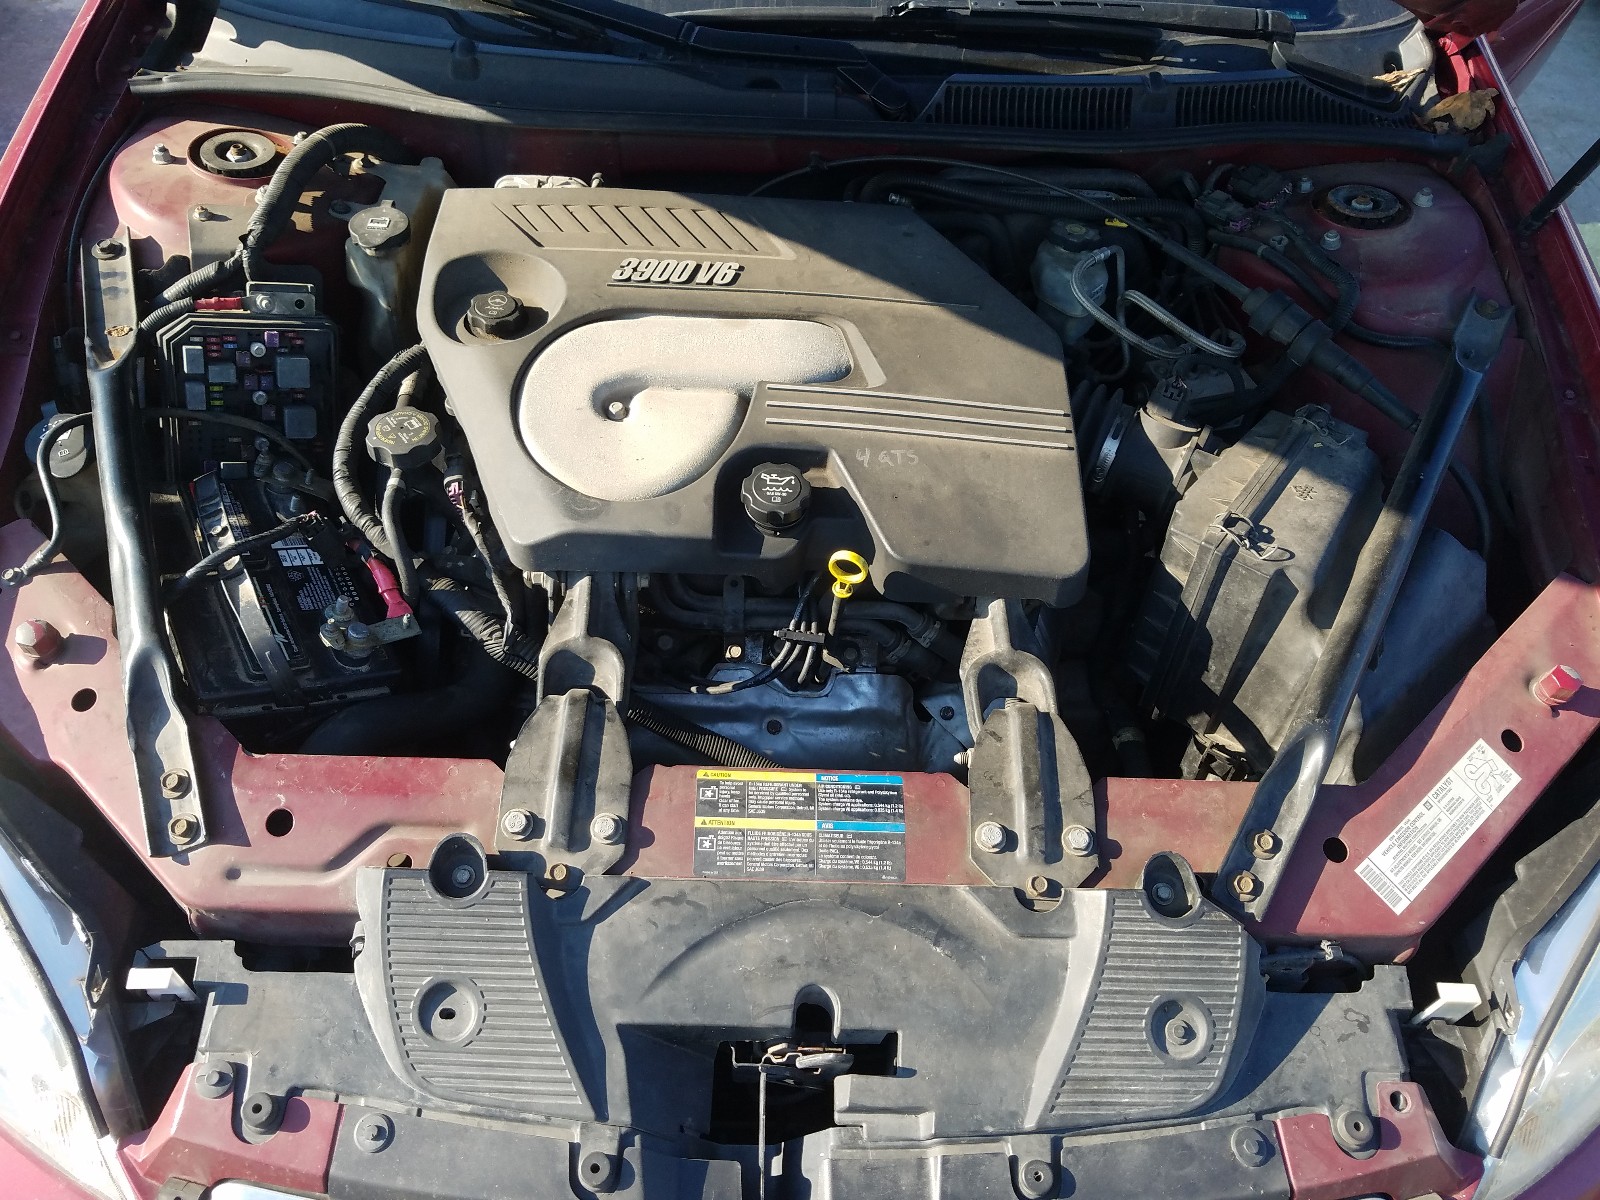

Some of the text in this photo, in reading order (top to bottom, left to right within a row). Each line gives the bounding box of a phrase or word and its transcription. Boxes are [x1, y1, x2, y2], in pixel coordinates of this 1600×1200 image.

[611, 258, 743, 286] 3900 V6
[856, 448, 869, 467] 4
[1430, 776, 1454, 800] CATALYST
